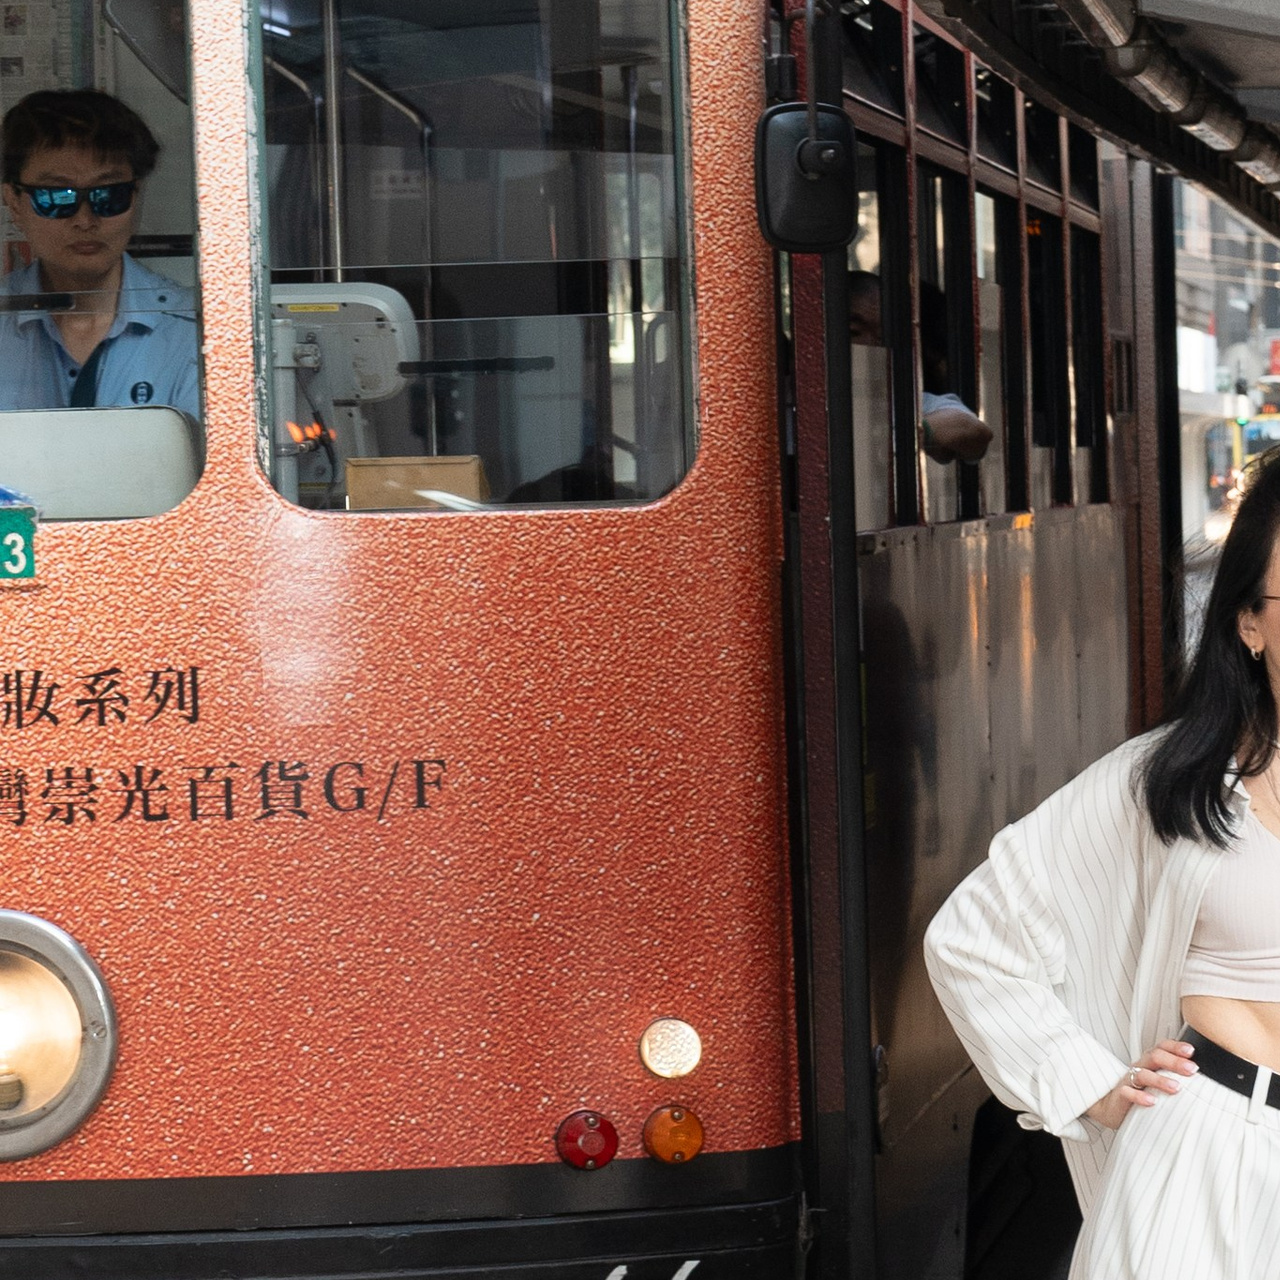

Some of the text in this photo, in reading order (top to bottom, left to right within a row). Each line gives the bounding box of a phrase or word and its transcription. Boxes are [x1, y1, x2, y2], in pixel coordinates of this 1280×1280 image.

[3, 532, 27, 574] 3
[0, 666, 200, 729] 妝系列
